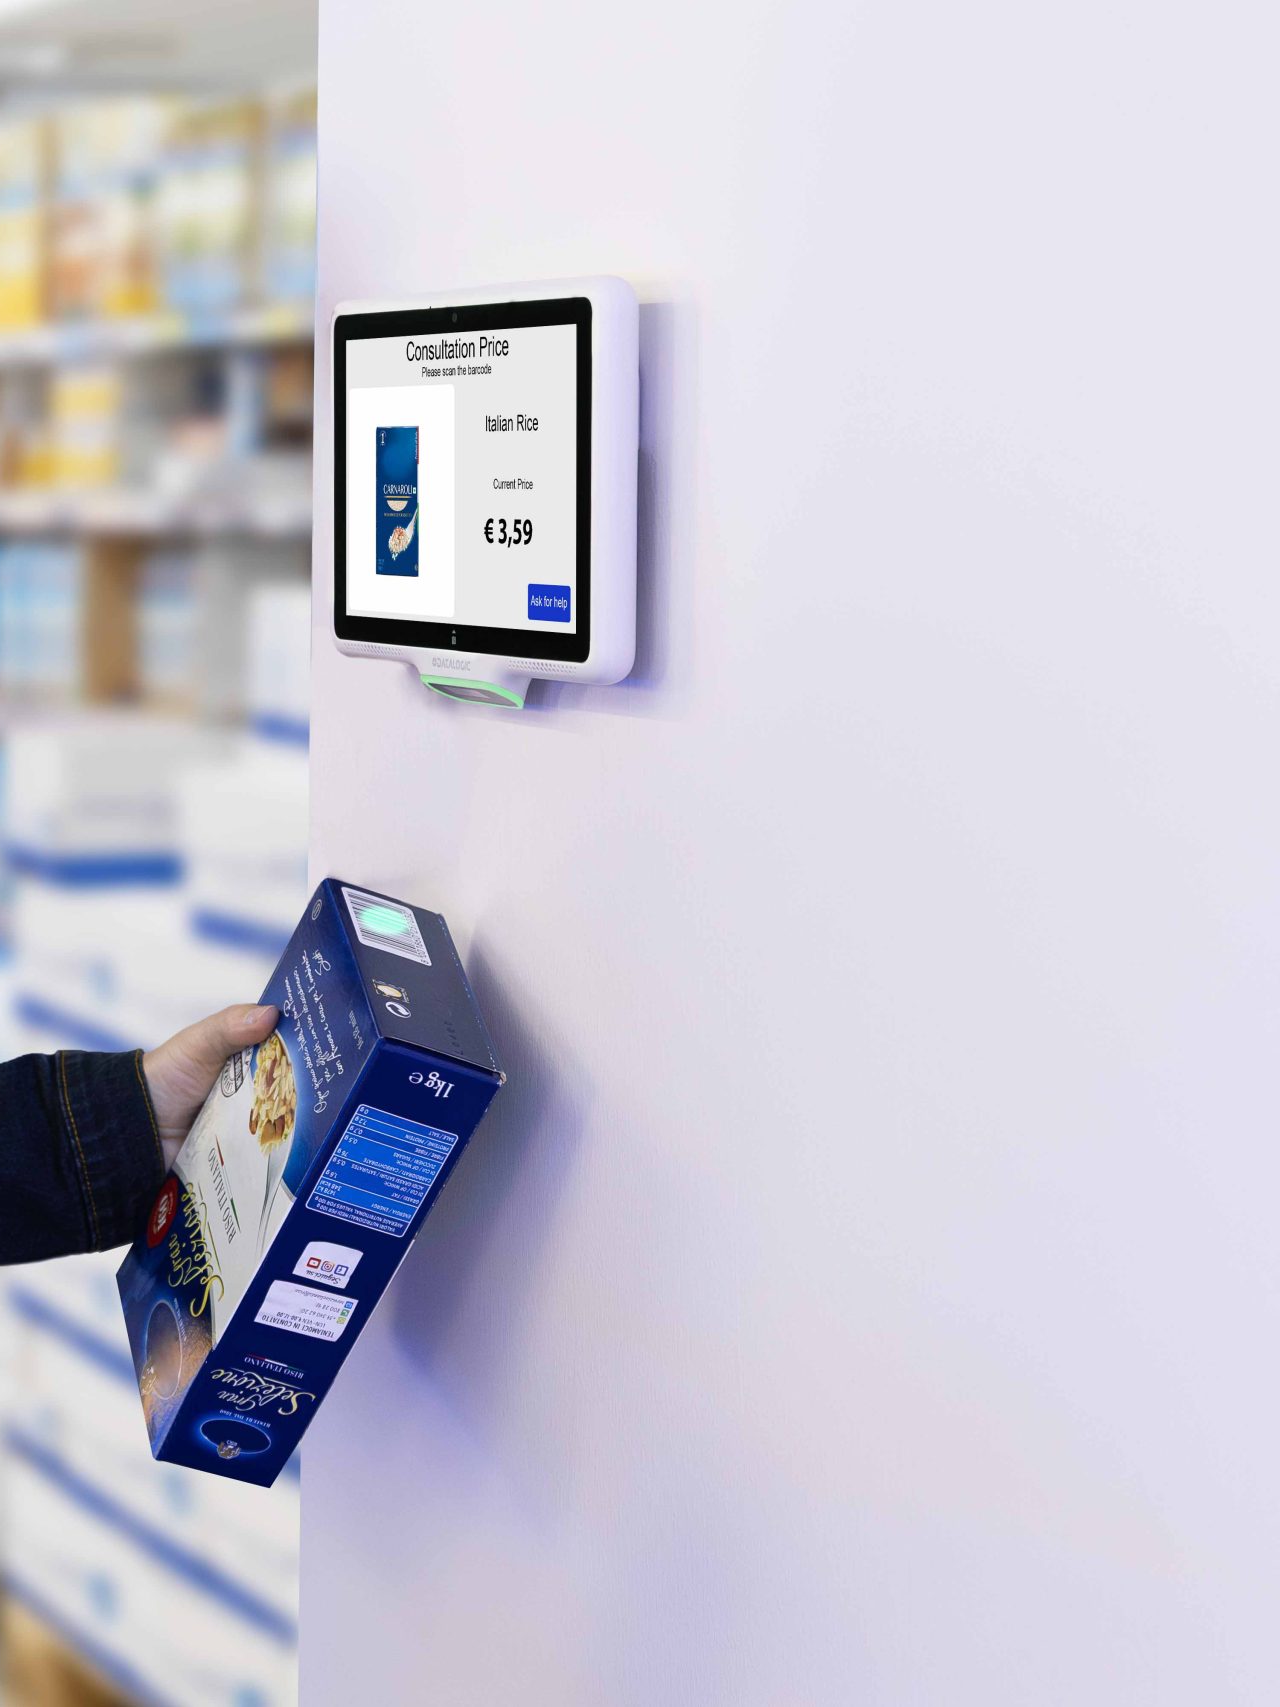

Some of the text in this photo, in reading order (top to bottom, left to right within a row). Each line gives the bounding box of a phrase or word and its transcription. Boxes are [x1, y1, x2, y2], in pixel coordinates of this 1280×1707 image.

[406, 335, 509, 361] Consultation Price
[422, 363, 491, 378] Please scan the barcode
[485, 414, 539, 432] Italian Rice
[383, 483, 412, 495] CARNAROLI
[493, 478, 534, 490] Current Price
[483, 518, 533, 548] € 3,59
[530, 594, 568, 611] Ask for help
[326, 1030, 341, 1061] Amore
[335, 1059, 343, 1076] con
[424, 1072, 455, 1098] 1kg
[430, 1153, 445, 1161] FIBRE
[208, 1147, 237, 1245] RISO ITALIANO
[181, 1182, 224, 1317] Selezione
[168, 1233, 192, 1287] Gran
[313, 1271, 343, 1285] Seguici
[261, 1315, 293, 1327] CONTATTO
[301, 1325, 335, 1338] TENIAMOCI
[243, 1357, 305, 1379] RISO ITALIANO
[211, 1370, 315, 1414] Selezione
[217, 1391, 260, 1411] Gran
